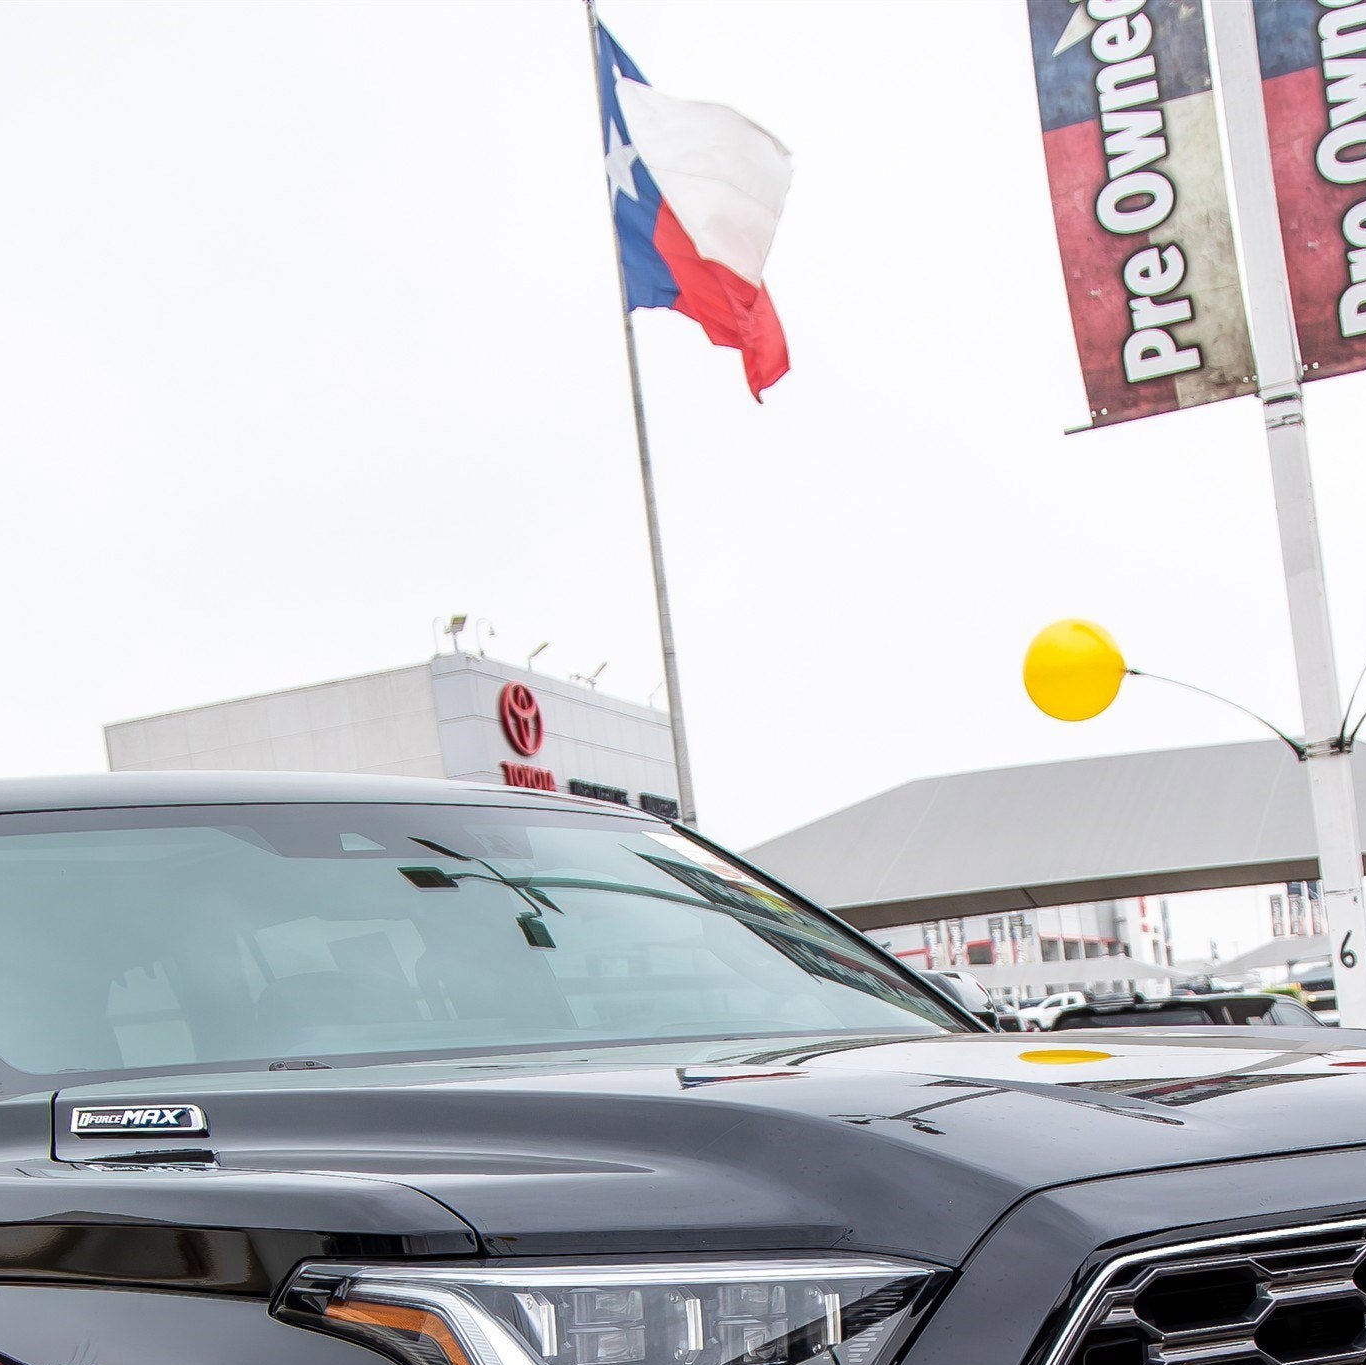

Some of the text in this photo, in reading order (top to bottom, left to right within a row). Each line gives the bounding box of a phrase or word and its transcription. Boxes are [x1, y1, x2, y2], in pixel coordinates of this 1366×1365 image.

[1122, 244, 1203, 384] Pre
[500, 760, 557, 792] TOYOTA
[1339, 930, 1358, 969] 6
